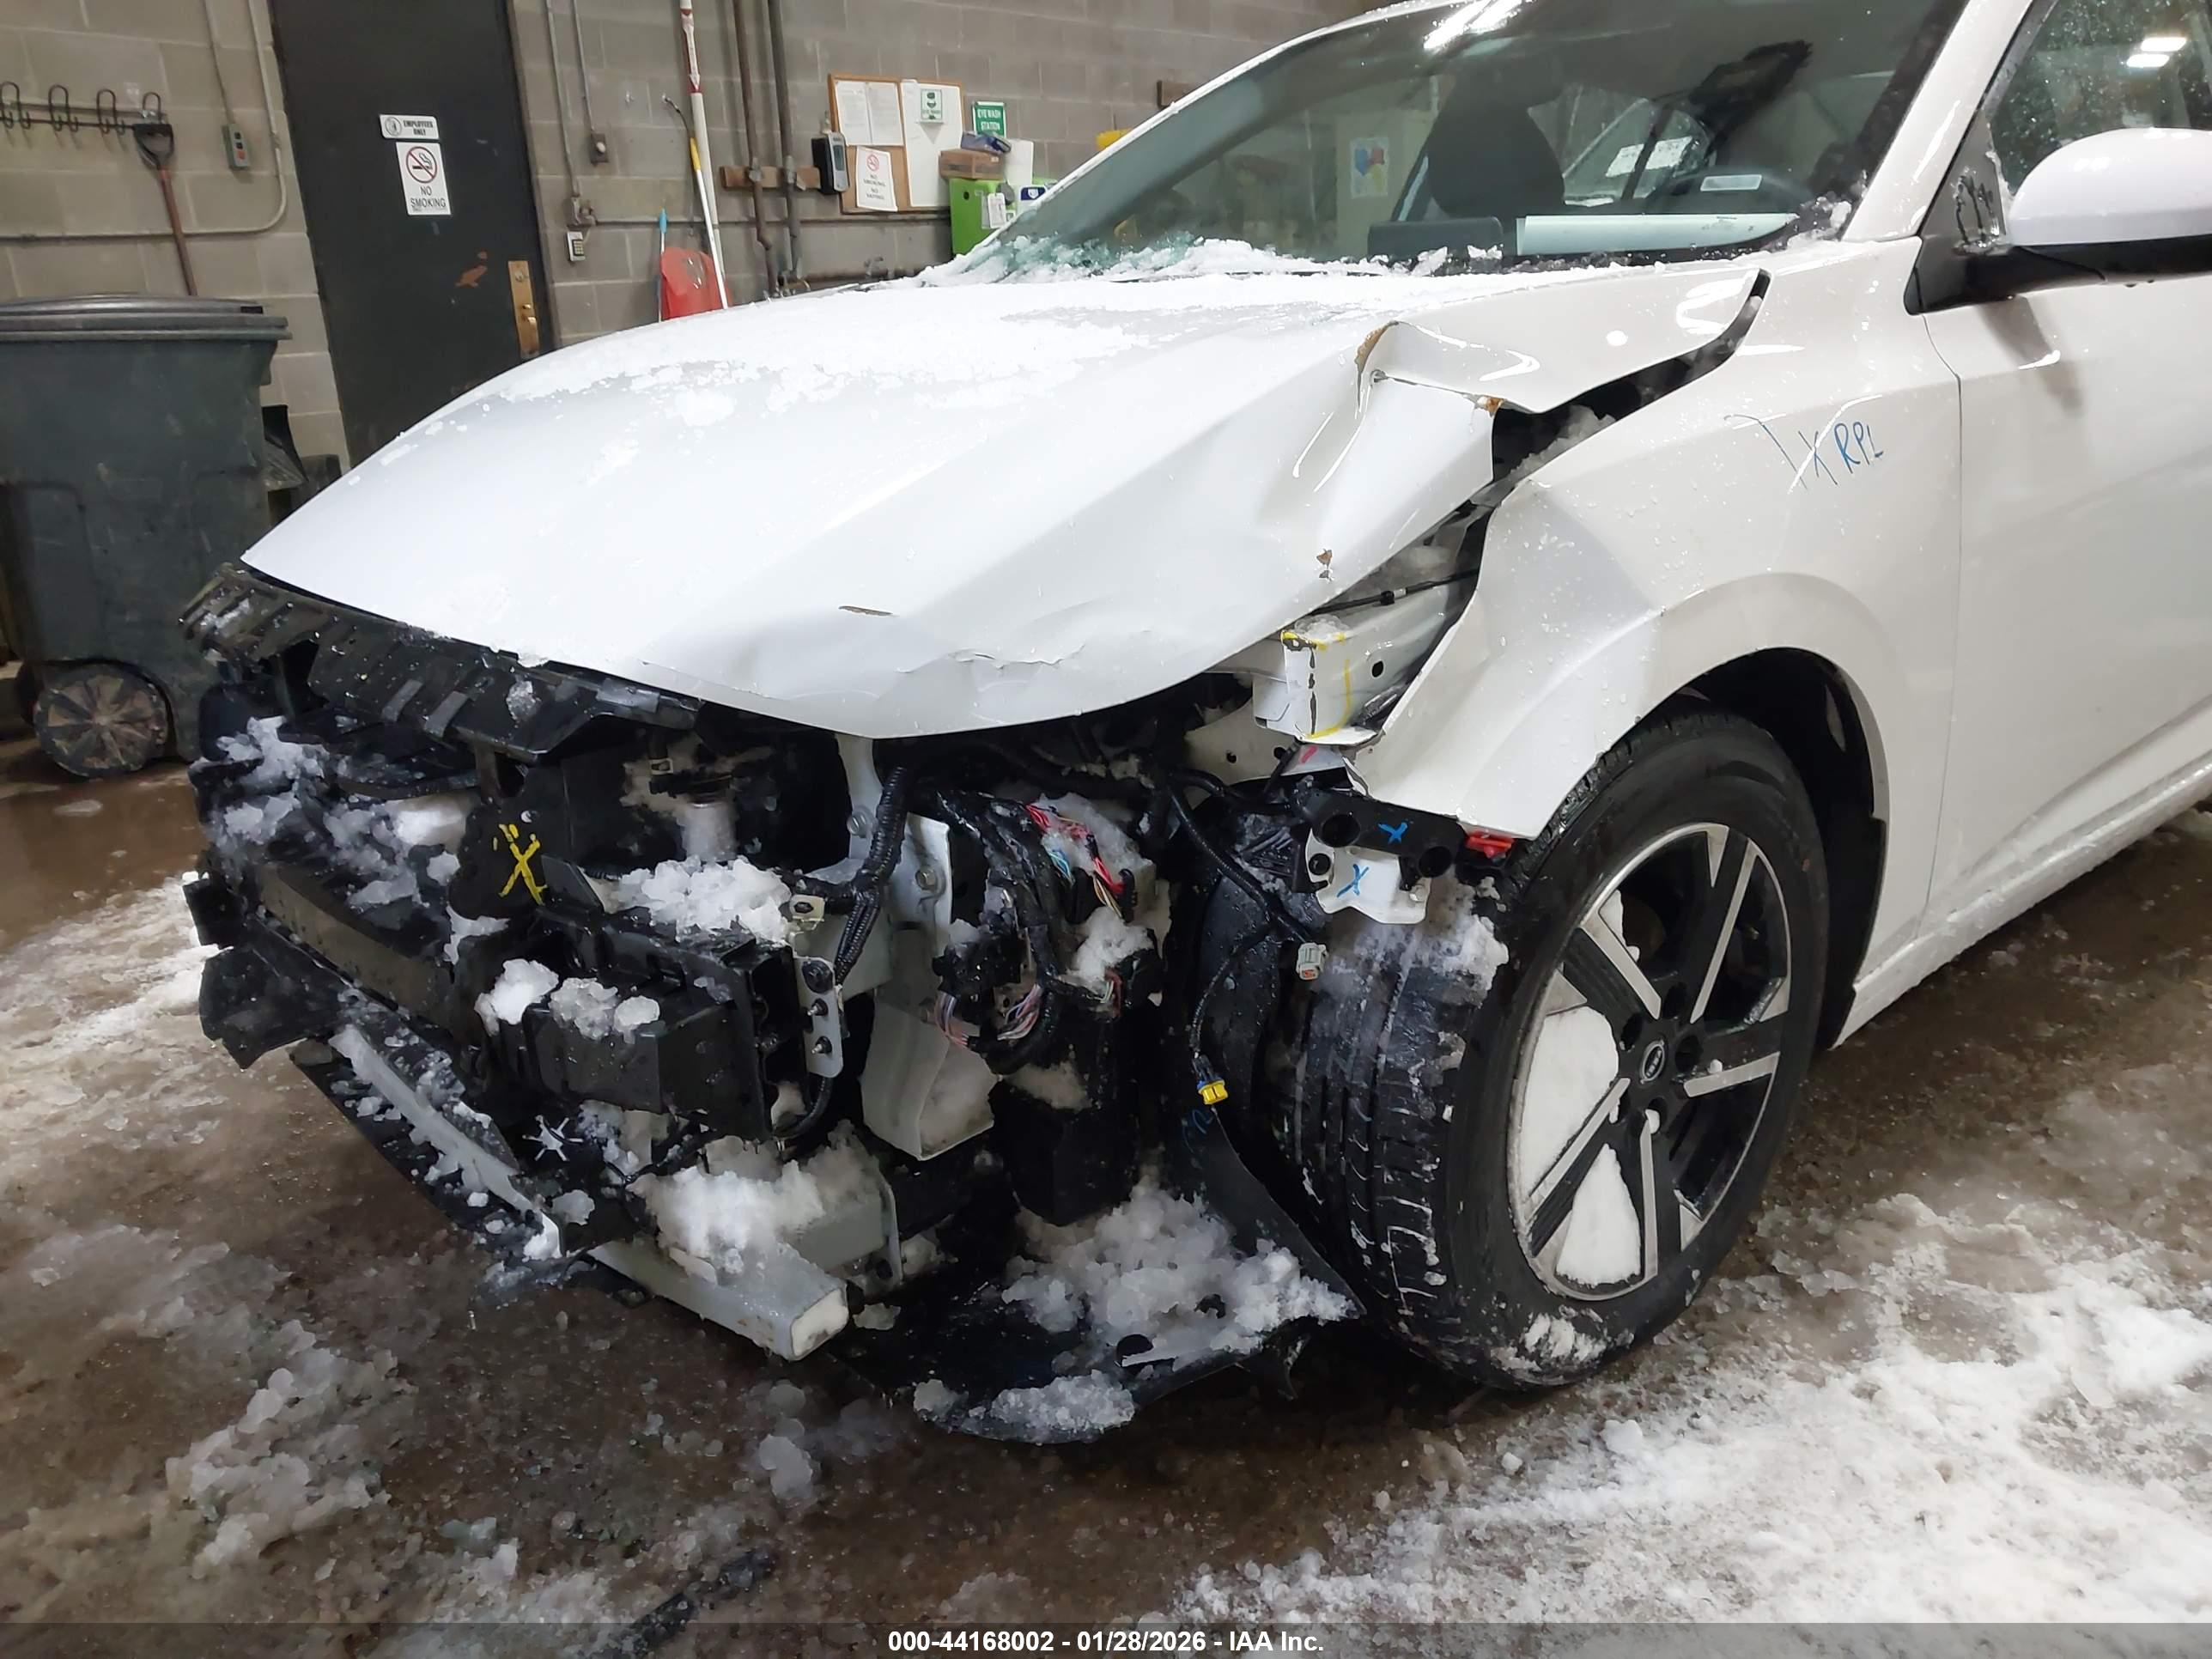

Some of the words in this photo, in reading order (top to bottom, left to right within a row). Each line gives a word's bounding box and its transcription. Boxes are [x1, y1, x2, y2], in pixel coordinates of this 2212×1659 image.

[981, 121, 1000, 131] STATION
[420, 185, 432, 196] NO
[410, 198, 447, 208] SMOKING
